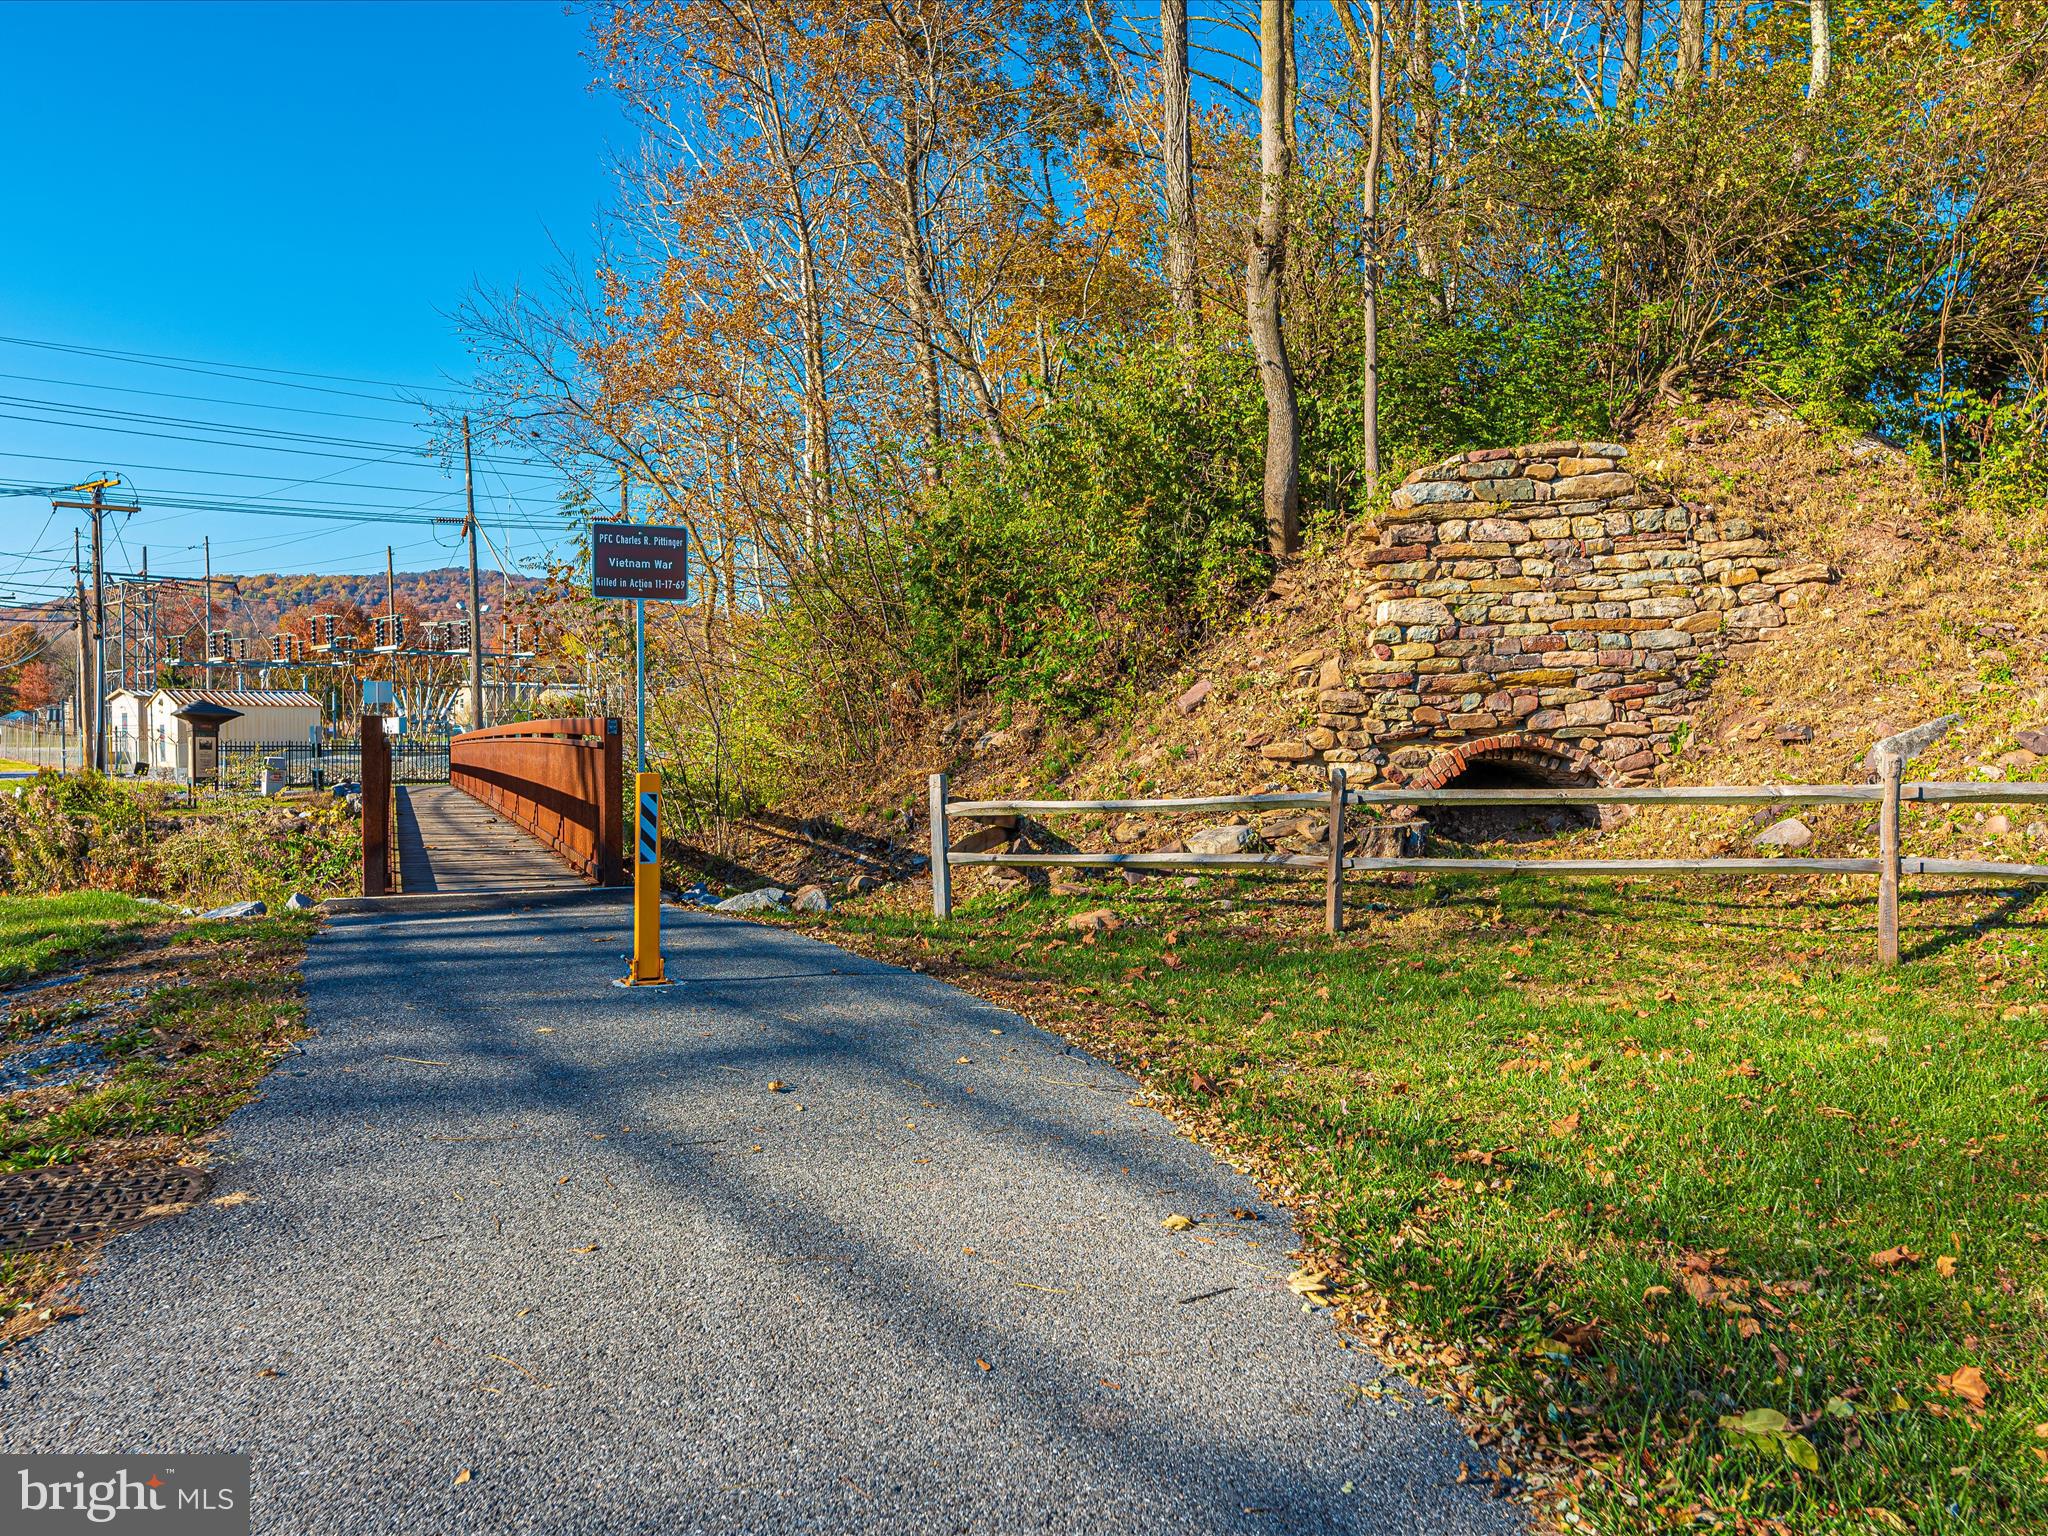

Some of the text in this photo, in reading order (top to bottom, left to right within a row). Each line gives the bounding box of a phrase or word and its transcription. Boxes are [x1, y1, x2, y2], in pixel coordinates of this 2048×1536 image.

[599, 534, 683, 549] PFC Charles R. Pittinger
[608, 557, 673, 570] Vietnam War
[595, 576, 685, 590] Killed in Action 11-17-69
